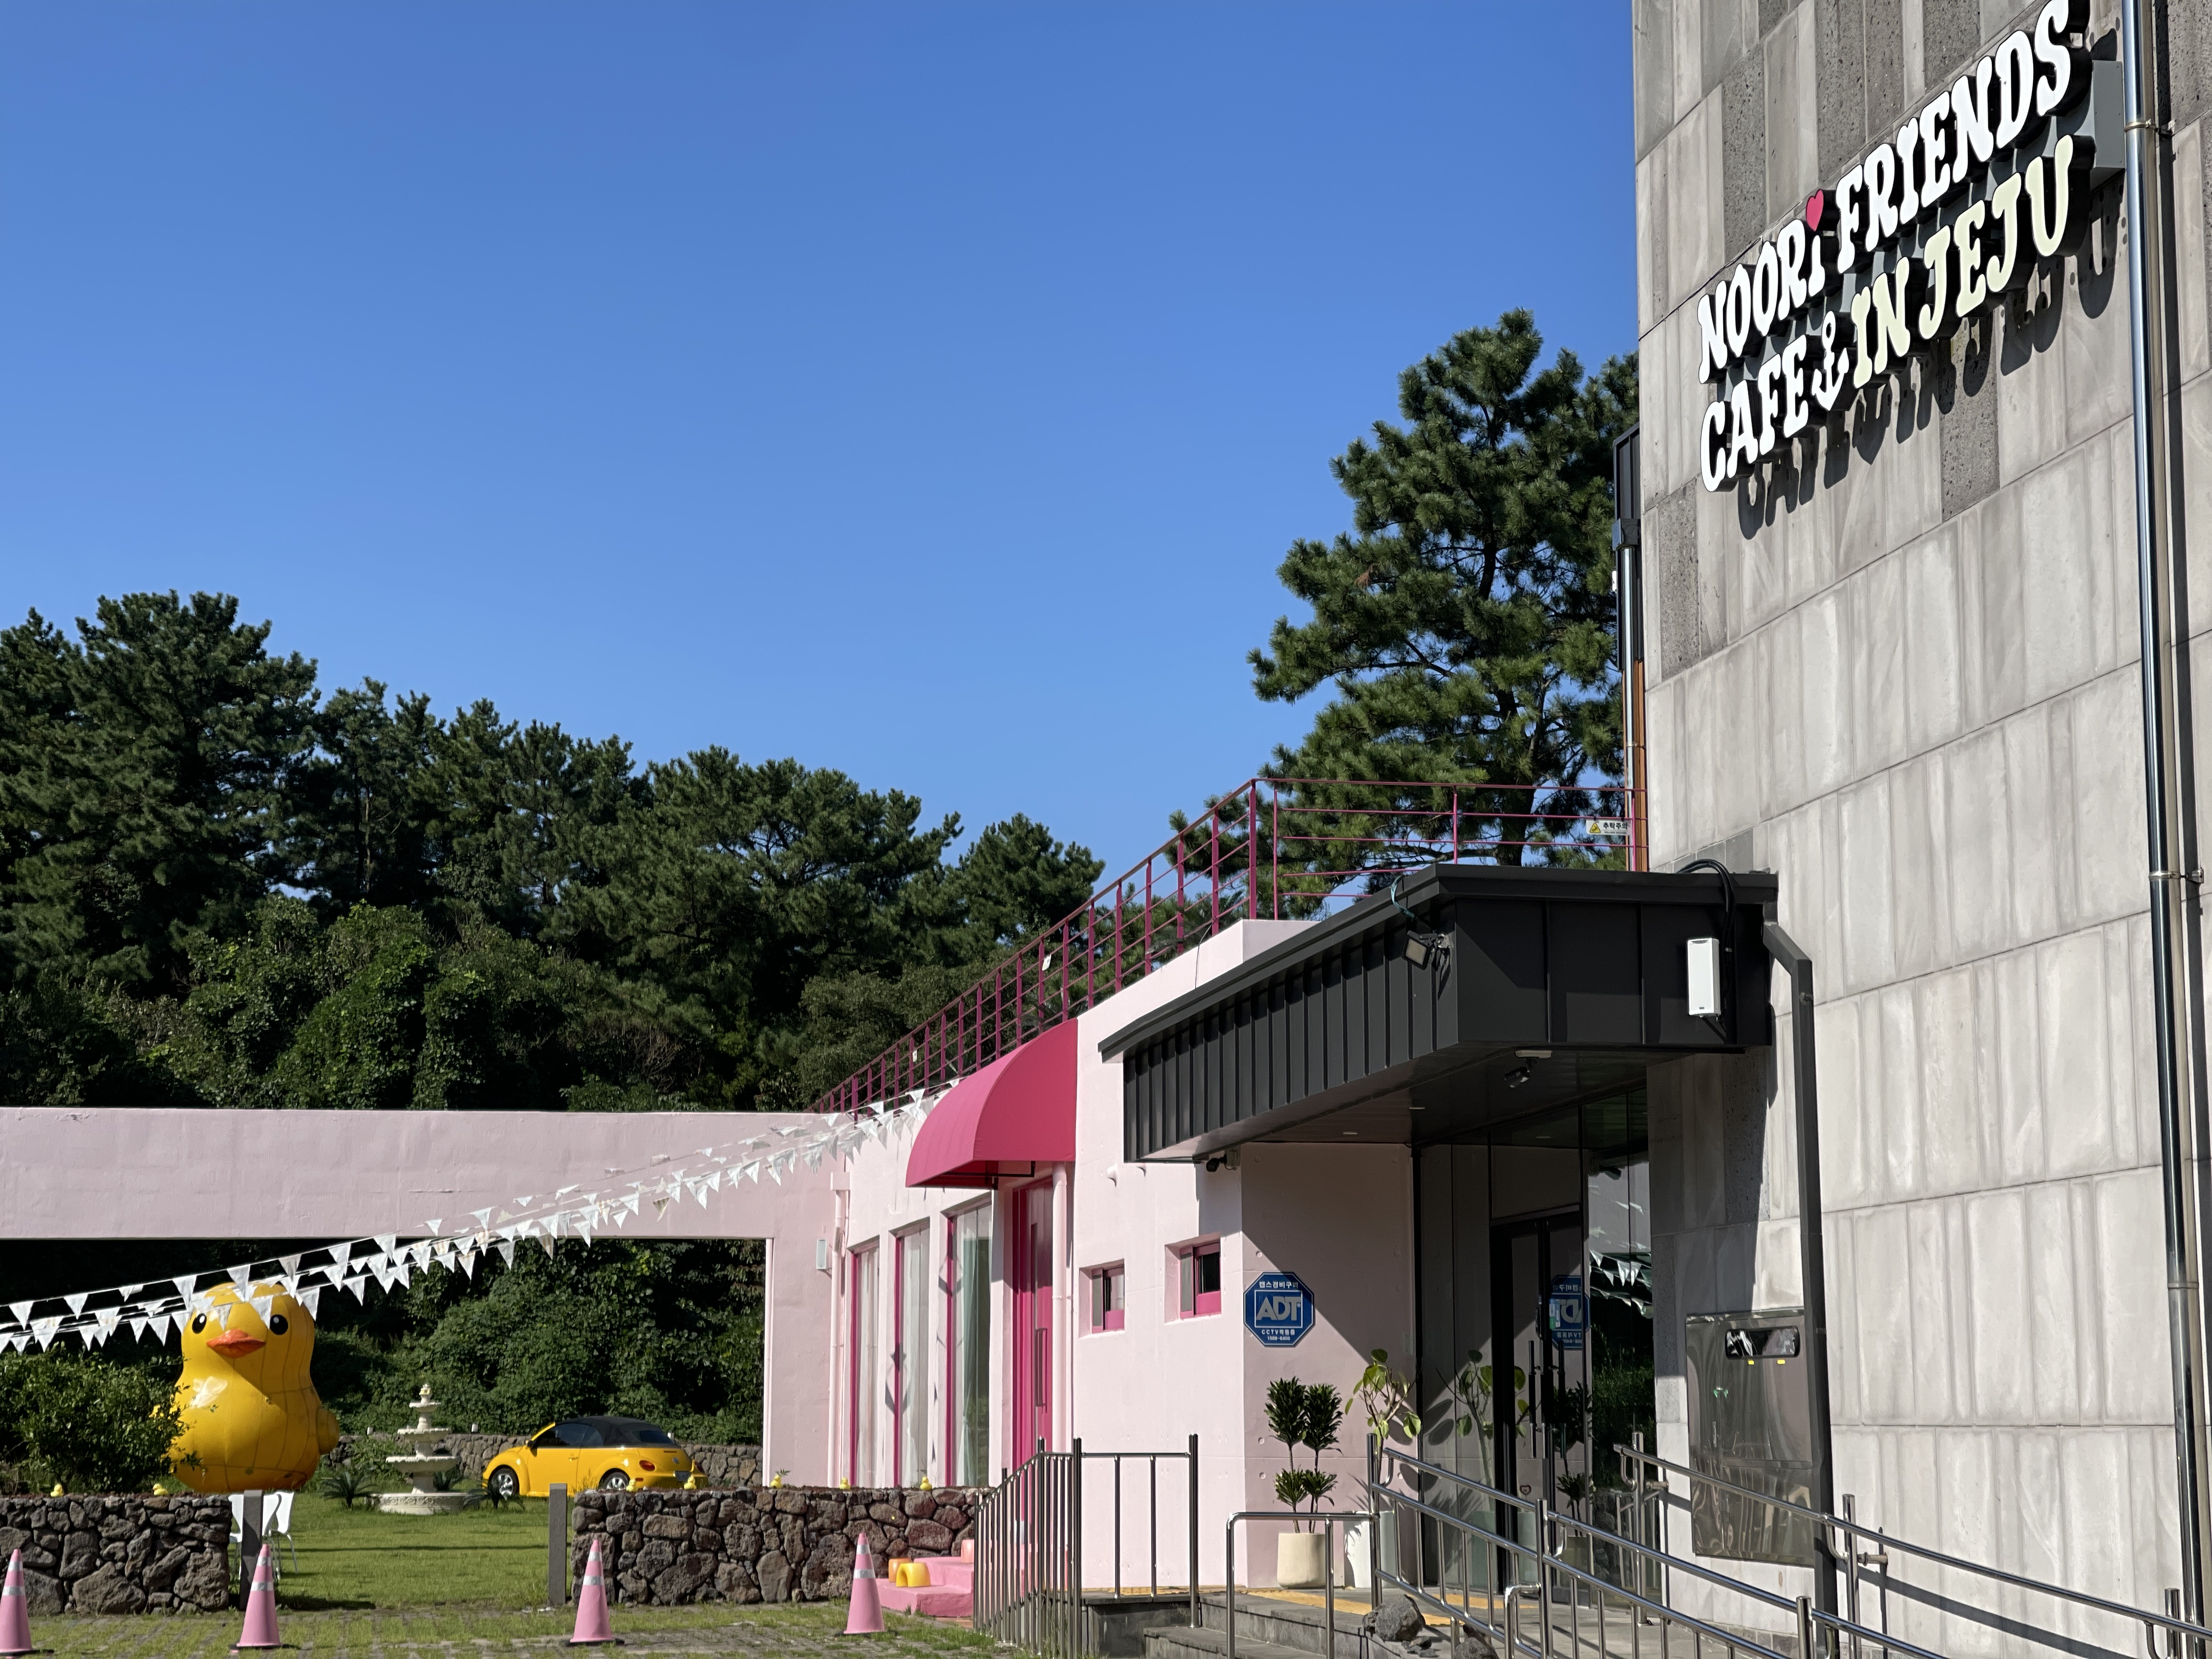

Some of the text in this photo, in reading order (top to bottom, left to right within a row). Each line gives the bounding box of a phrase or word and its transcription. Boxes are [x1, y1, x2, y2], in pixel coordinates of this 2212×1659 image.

[1836, 0, 2072, 274] FRIENDS
[1700, 335, 1808, 492] CAFE
[1851, 257, 1910, 388] IN
[1918, 134, 2073, 340] JEJU
[1603, 822, 1628, 830] 추락주의
[1256, 1296, 1301, 1321] ADT
